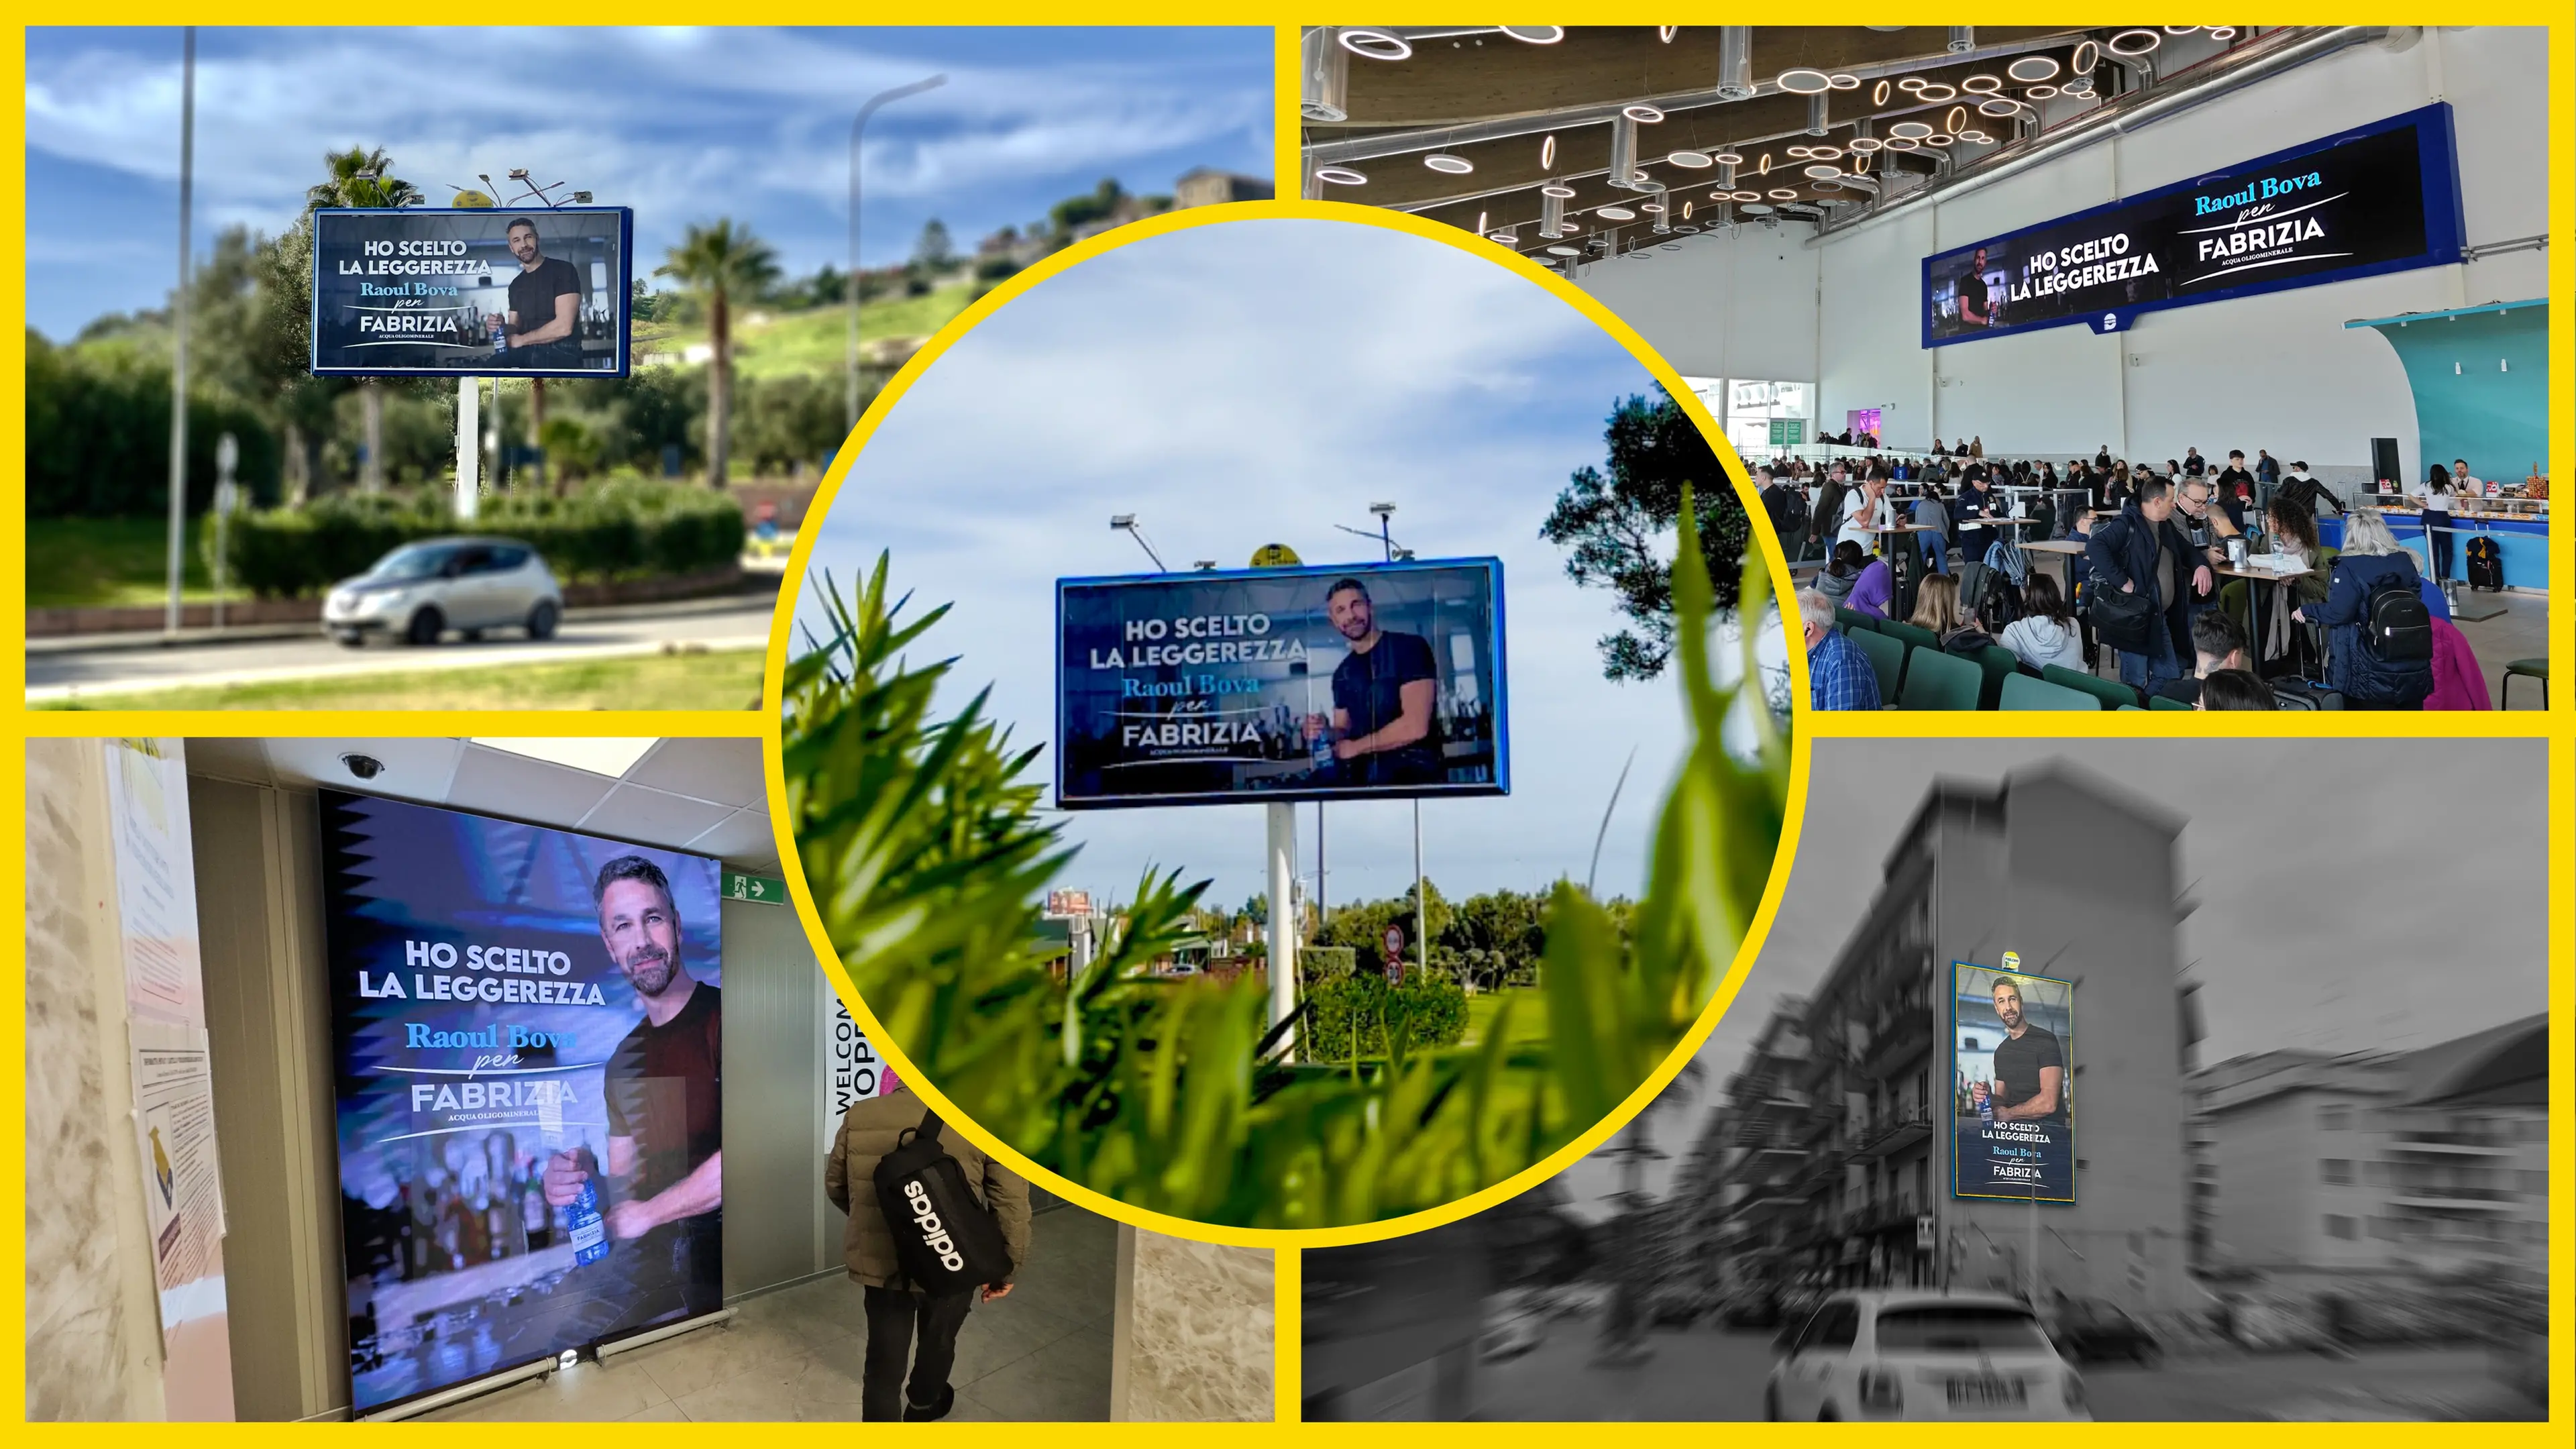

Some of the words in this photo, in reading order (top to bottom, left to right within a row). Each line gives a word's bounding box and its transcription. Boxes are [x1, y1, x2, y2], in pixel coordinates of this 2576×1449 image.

[2195, 182, 2256, 216] Raoul
[2260, 171, 2322, 199] Bova
[2234, 202, 2275, 231] per
[364, 240, 394, 256] HO
[398, 240, 468, 256] SCELTO
[2198, 217, 2325, 262] FABRIZIA
[2030, 252, 2057, 274] HO
[2060, 233, 2129, 266] SCELTO
[2221, 258, 2241, 267] ACQUA
[2241, 247, 2294, 262] OLIGOMINERALE
[339, 260, 364, 275] LA
[368, 259, 492, 275] LEGGEREZZA
[2010, 280, 2032, 302] LA
[2035, 253, 2159, 297] LEGGEREZZA
[360, 282, 411, 296] Raoul
[413, 282, 458, 296] Bova
[391, 299, 425, 314] per
[360, 316, 458, 332] FABRIZIA
[1126, 619, 1167, 641] HO
[1175, 613, 1271, 639] SCELTO
[1090, 647, 1125, 669] LA
[1132, 639, 1308, 667] LEGGEREZZA
[1122, 676, 1193, 698] Raoul
[1198, 674, 1259, 695] Bova
[1167, 699, 1212, 720] per
[1123, 722, 1261, 747] FABRIZIA
[406, 940, 459, 969] HO
[466, 945, 571, 976] SCELTO
[359, 970, 407, 999] LA
[415, 973, 606, 1006] LEGGEREZZA
[405, 1022, 498, 1049] Raoul
[506, 1024, 577, 1049] Bova
[468, 1053, 525, 1080] per
[411, 1080, 578, 1112] FABRIZIA
[448, 1113, 476, 1122] ACQUA
[477, 1110, 543, 1120] OLIGOMINERAL
[1994, 1121, 2008, 1130] HO
[1982, 1130, 1994, 1139] LA
[1996, 1131, 2051, 1143] LEGGEREZZA
[1992, 1146, 2018, 1156] Raoul
[2019, 1148, 2041, 1158] Boa
[1993, 1166, 2041, 1178] FABRIZA
[904, 1180, 963, 1272] adidas
